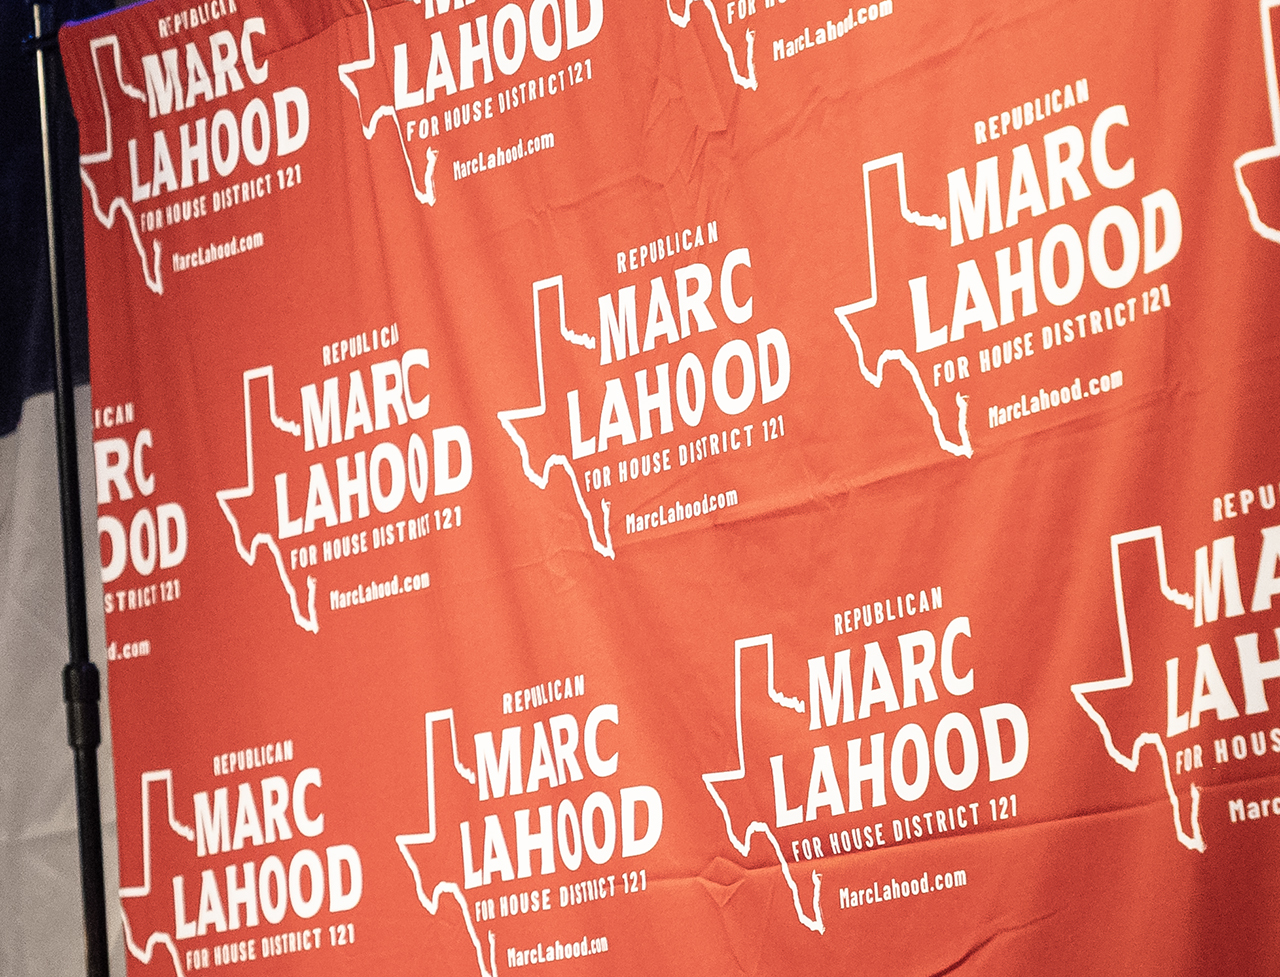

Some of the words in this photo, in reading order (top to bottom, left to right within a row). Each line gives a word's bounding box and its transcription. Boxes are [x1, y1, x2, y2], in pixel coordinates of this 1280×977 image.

[142, 17, 268, 118] MARC
[394, 0, 604, 111] LAHOOD
[406, 115, 440, 142] FOR
[444, 97, 494, 132] HOUSE
[498, 69, 566, 114] DISTRICT
[567, 58, 593, 86] 121
[974, 78, 1090, 145] REPUBLICAN
[128, 87, 309, 202] LAHOOD
[452, 132, 556, 181] MarcLahood.com
[947, 105, 1134, 247] MARC
[166, 195, 207, 225] HOUSE
[212, 173, 271, 212] DISTRICT
[276, 164, 302, 190] 121
[172, 232, 264, 271] MarcLahood.com
[616, 220, 719, 274] REPUBLICAN
[908, 189, 1182, 353] LAHOOD
[598, 248, 752, 365] MARC
[933, 355, 970, 387] FOR
[978, 332, 1035, 373] HOUSE
[1041, 297, 1137, 350] DISTRICT
[1141, 283, 1171, 315] 121
[301, 349, 430, 451] MARC
[567, 328, 790, 460] LAHOOD
[988, 370, 1123, 429] MarcLahood.com
[275, 425, 472, 539] LAHOOD
[584, 465, 612, 493] FOR
[618, 448, 672, 483] HOUSE
[678, 424, 754, 467] DISTRICT
[761, 414, 785, 442] 121
[290, 544, 318, 570] FOR
[322, 531, 368, 562] HOUSE
[371, 512, 431, 550] DISTRICT
[433, 504, 462, 531] 121
[625, 489, 739, 535] MarcLahood.com
[160, 578, 181, 602] 121
[329, 572, 430, 611] MarcLahood.com
[833, 586, 943, 636] REPUBLICAN
[808, 617, 974, 730] MARC
[213, 739, 294, 776] REPUBLICAN
[474, 704, 619, 801] MARC
[770, 703, 1029, 827] LAHOOD
[1175, 744, 1203, 775] FOR
[194, 768, 324, 856] MARC
[460, 785, 663, 889] LAHOOD
[791, 836, 825, 863] FOR
[828, 822, 886, 855] HOUSE
[892, 802, 979, 842] DISTRICT
[989, 794, 1017, 822] 121
[173, 845, 362, 939] LAHOOD
[474, 898, 496, 922] FOR
[498, 887, 552, 918] HOUSE
[558, 874, 616, 909] DISTRICT
[621, 869, 647, 894] 121
[839, 869, 967, 909] MarcLahood.com
[186, 948, 209, 970] FOR
[213, 939, 256, 966] HOUSE
[261, 927, 322, 958] DISTRICT
[328, 923, 355, 947] 121
[506, 936, 609, 968] MarcLahood.com
